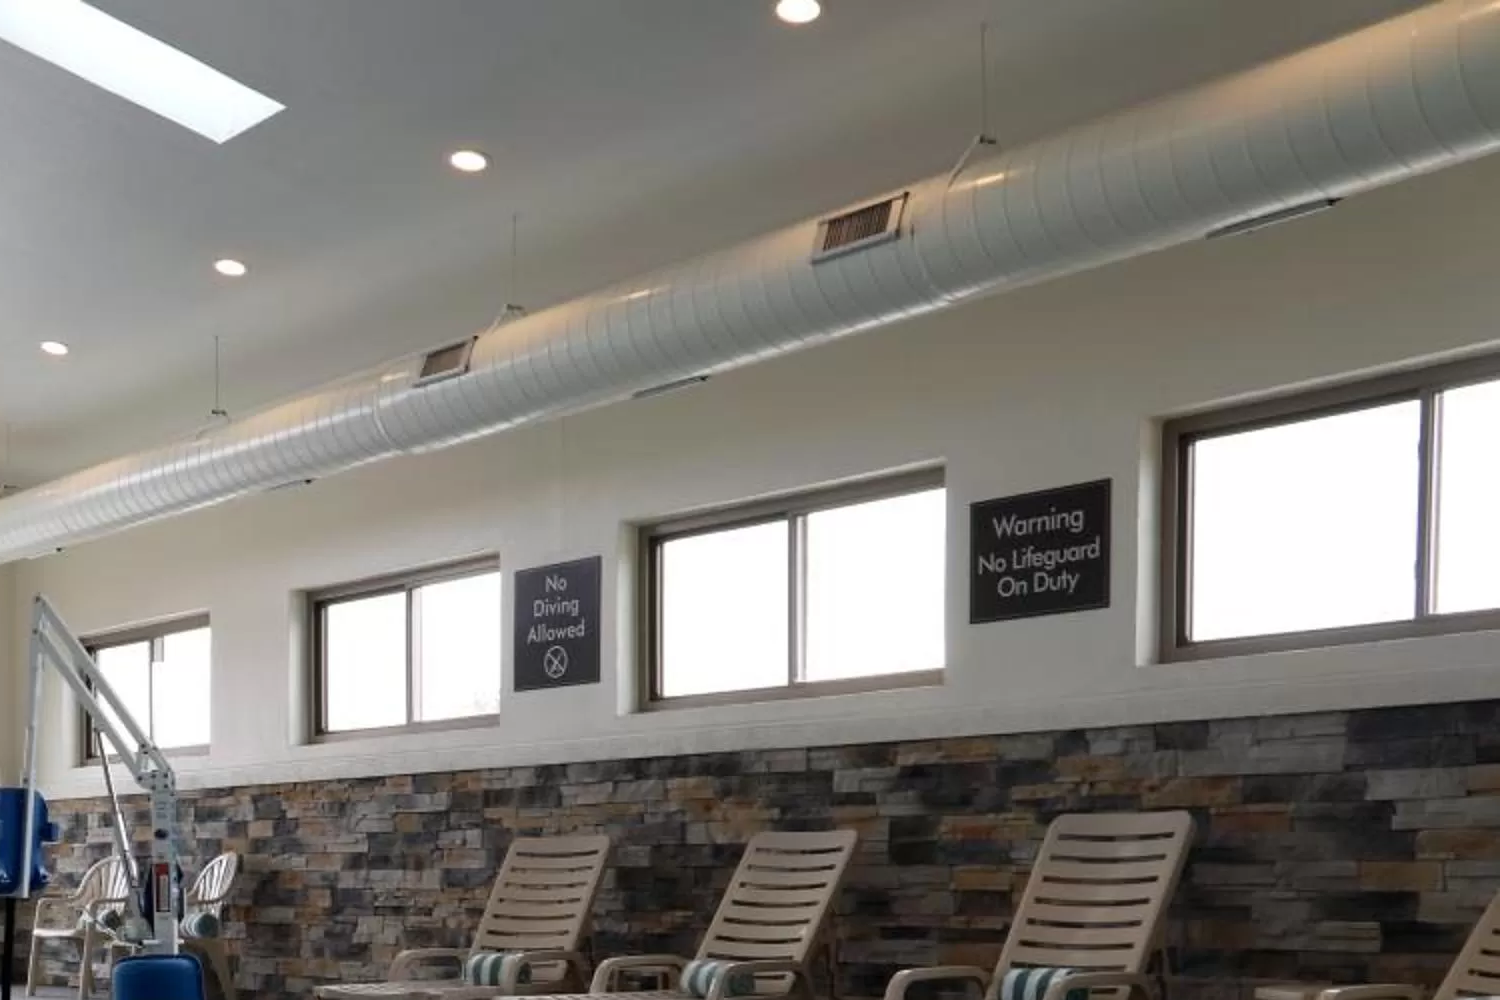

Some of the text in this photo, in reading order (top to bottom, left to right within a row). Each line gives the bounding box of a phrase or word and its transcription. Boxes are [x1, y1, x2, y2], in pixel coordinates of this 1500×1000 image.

[991, 506, 1084, 539] Warning
[978, 535, 1100, 575] No Lifeguard
[545, 574, 567, 592] No
[997, 570, 1080, 597] On Duty
[533, 597, 579, 617] Diving
[527, 616, 585, 644] Allowed
